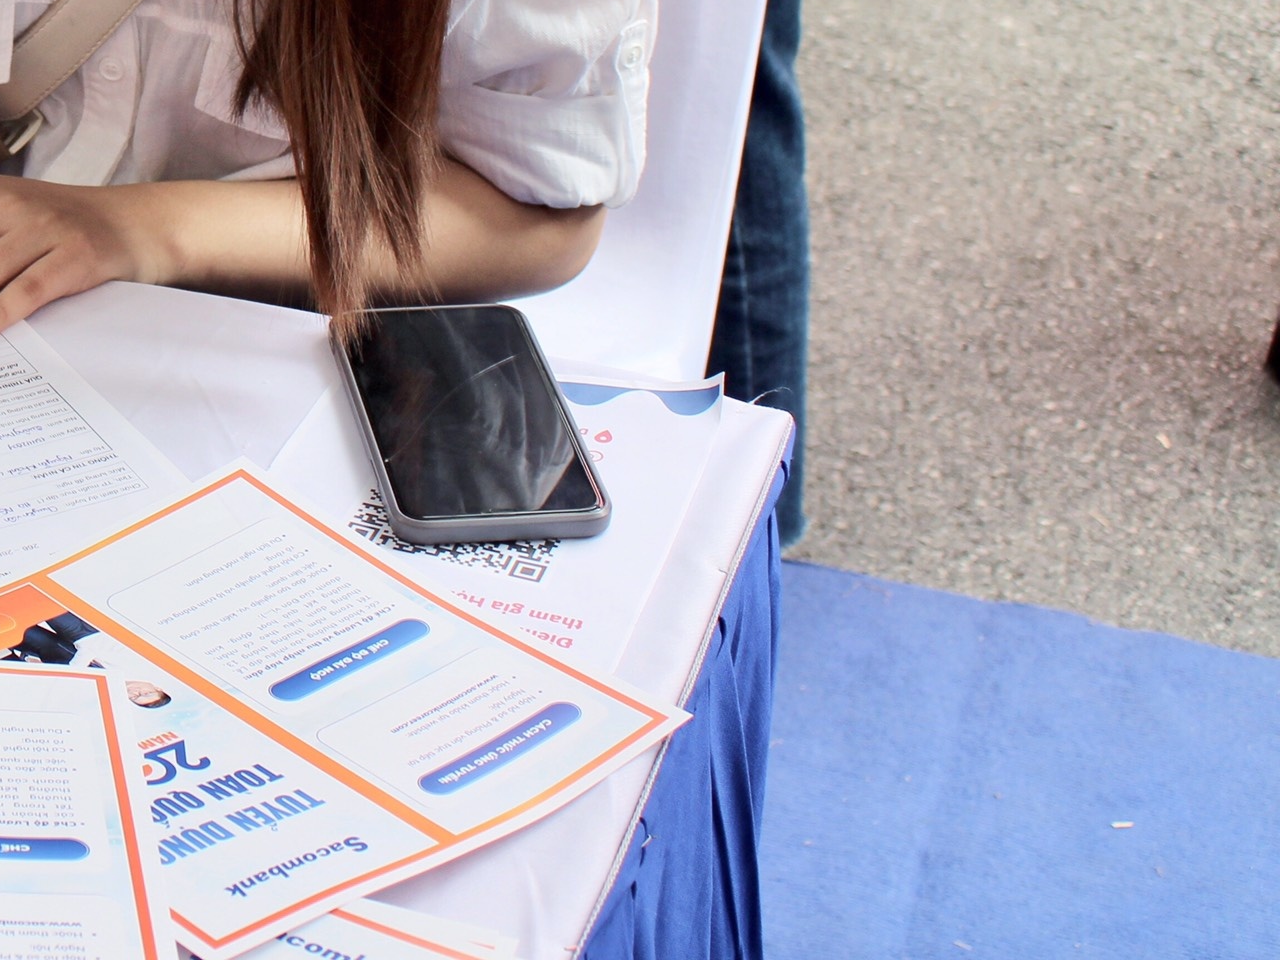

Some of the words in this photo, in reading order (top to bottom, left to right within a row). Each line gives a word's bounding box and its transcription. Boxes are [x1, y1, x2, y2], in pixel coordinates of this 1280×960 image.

[490, 600, 525, 616] gia
[528, 609, 584, 630] tham
[198, 763, 284, 805] TOÀN
[225, 788, 325, 839] TUYỂN
[225, 835, 368, 898] Sacombank
